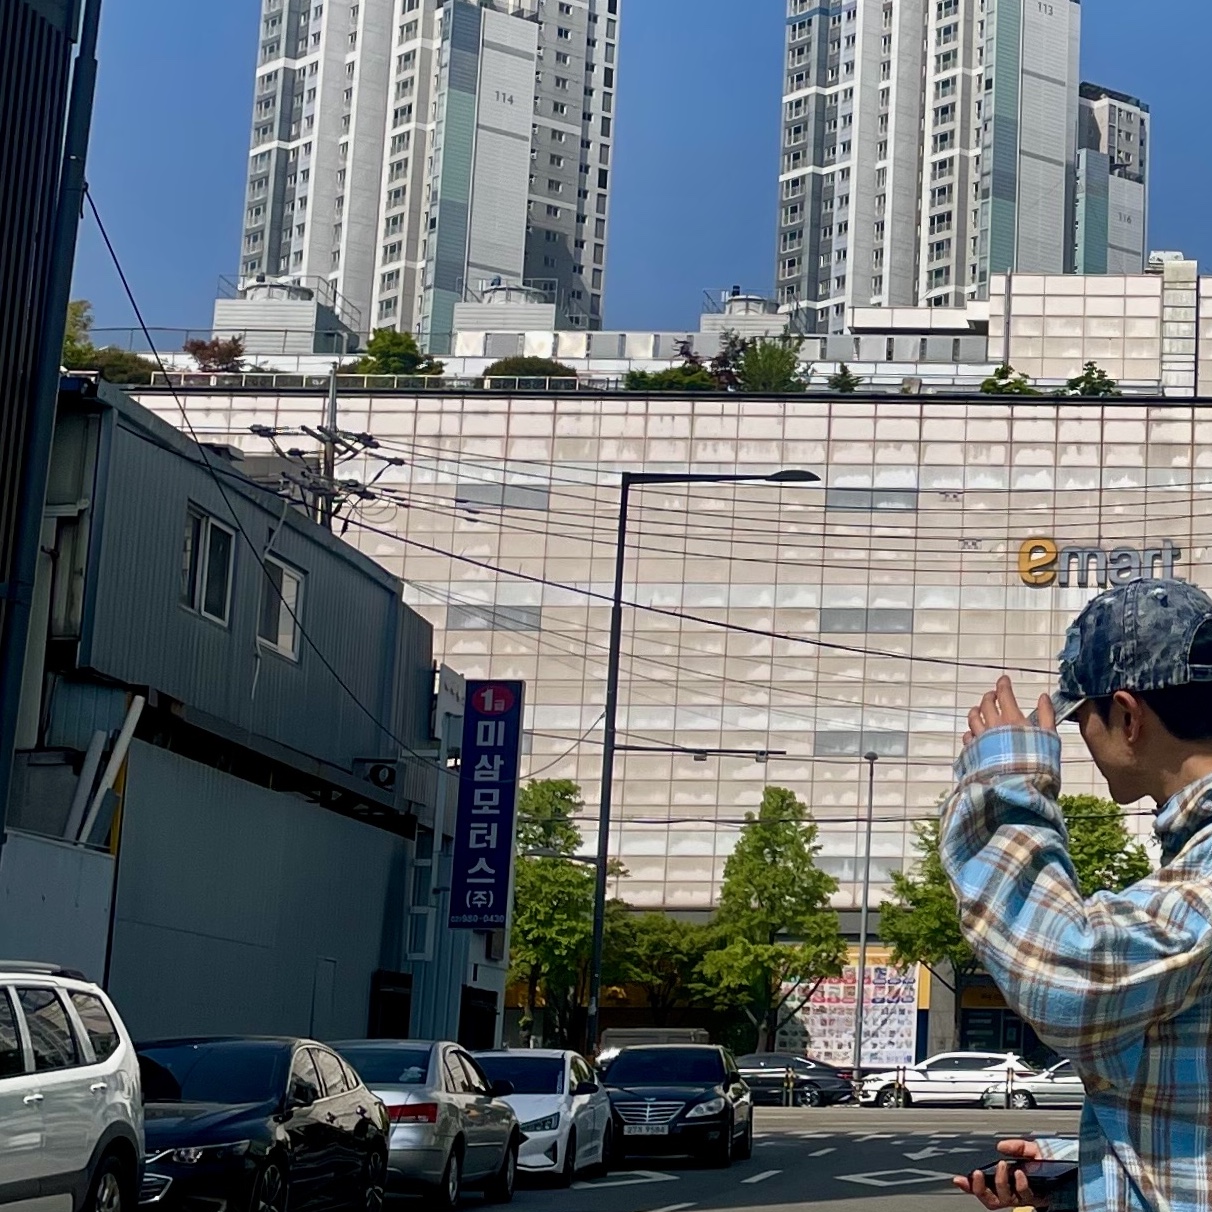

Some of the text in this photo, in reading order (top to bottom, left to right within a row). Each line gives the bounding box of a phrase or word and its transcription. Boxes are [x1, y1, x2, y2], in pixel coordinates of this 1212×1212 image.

[1037, 1, 1053, 16] 113
[495, 90, 514, 105] 114
[1018, 537, 1182, 588] emart
